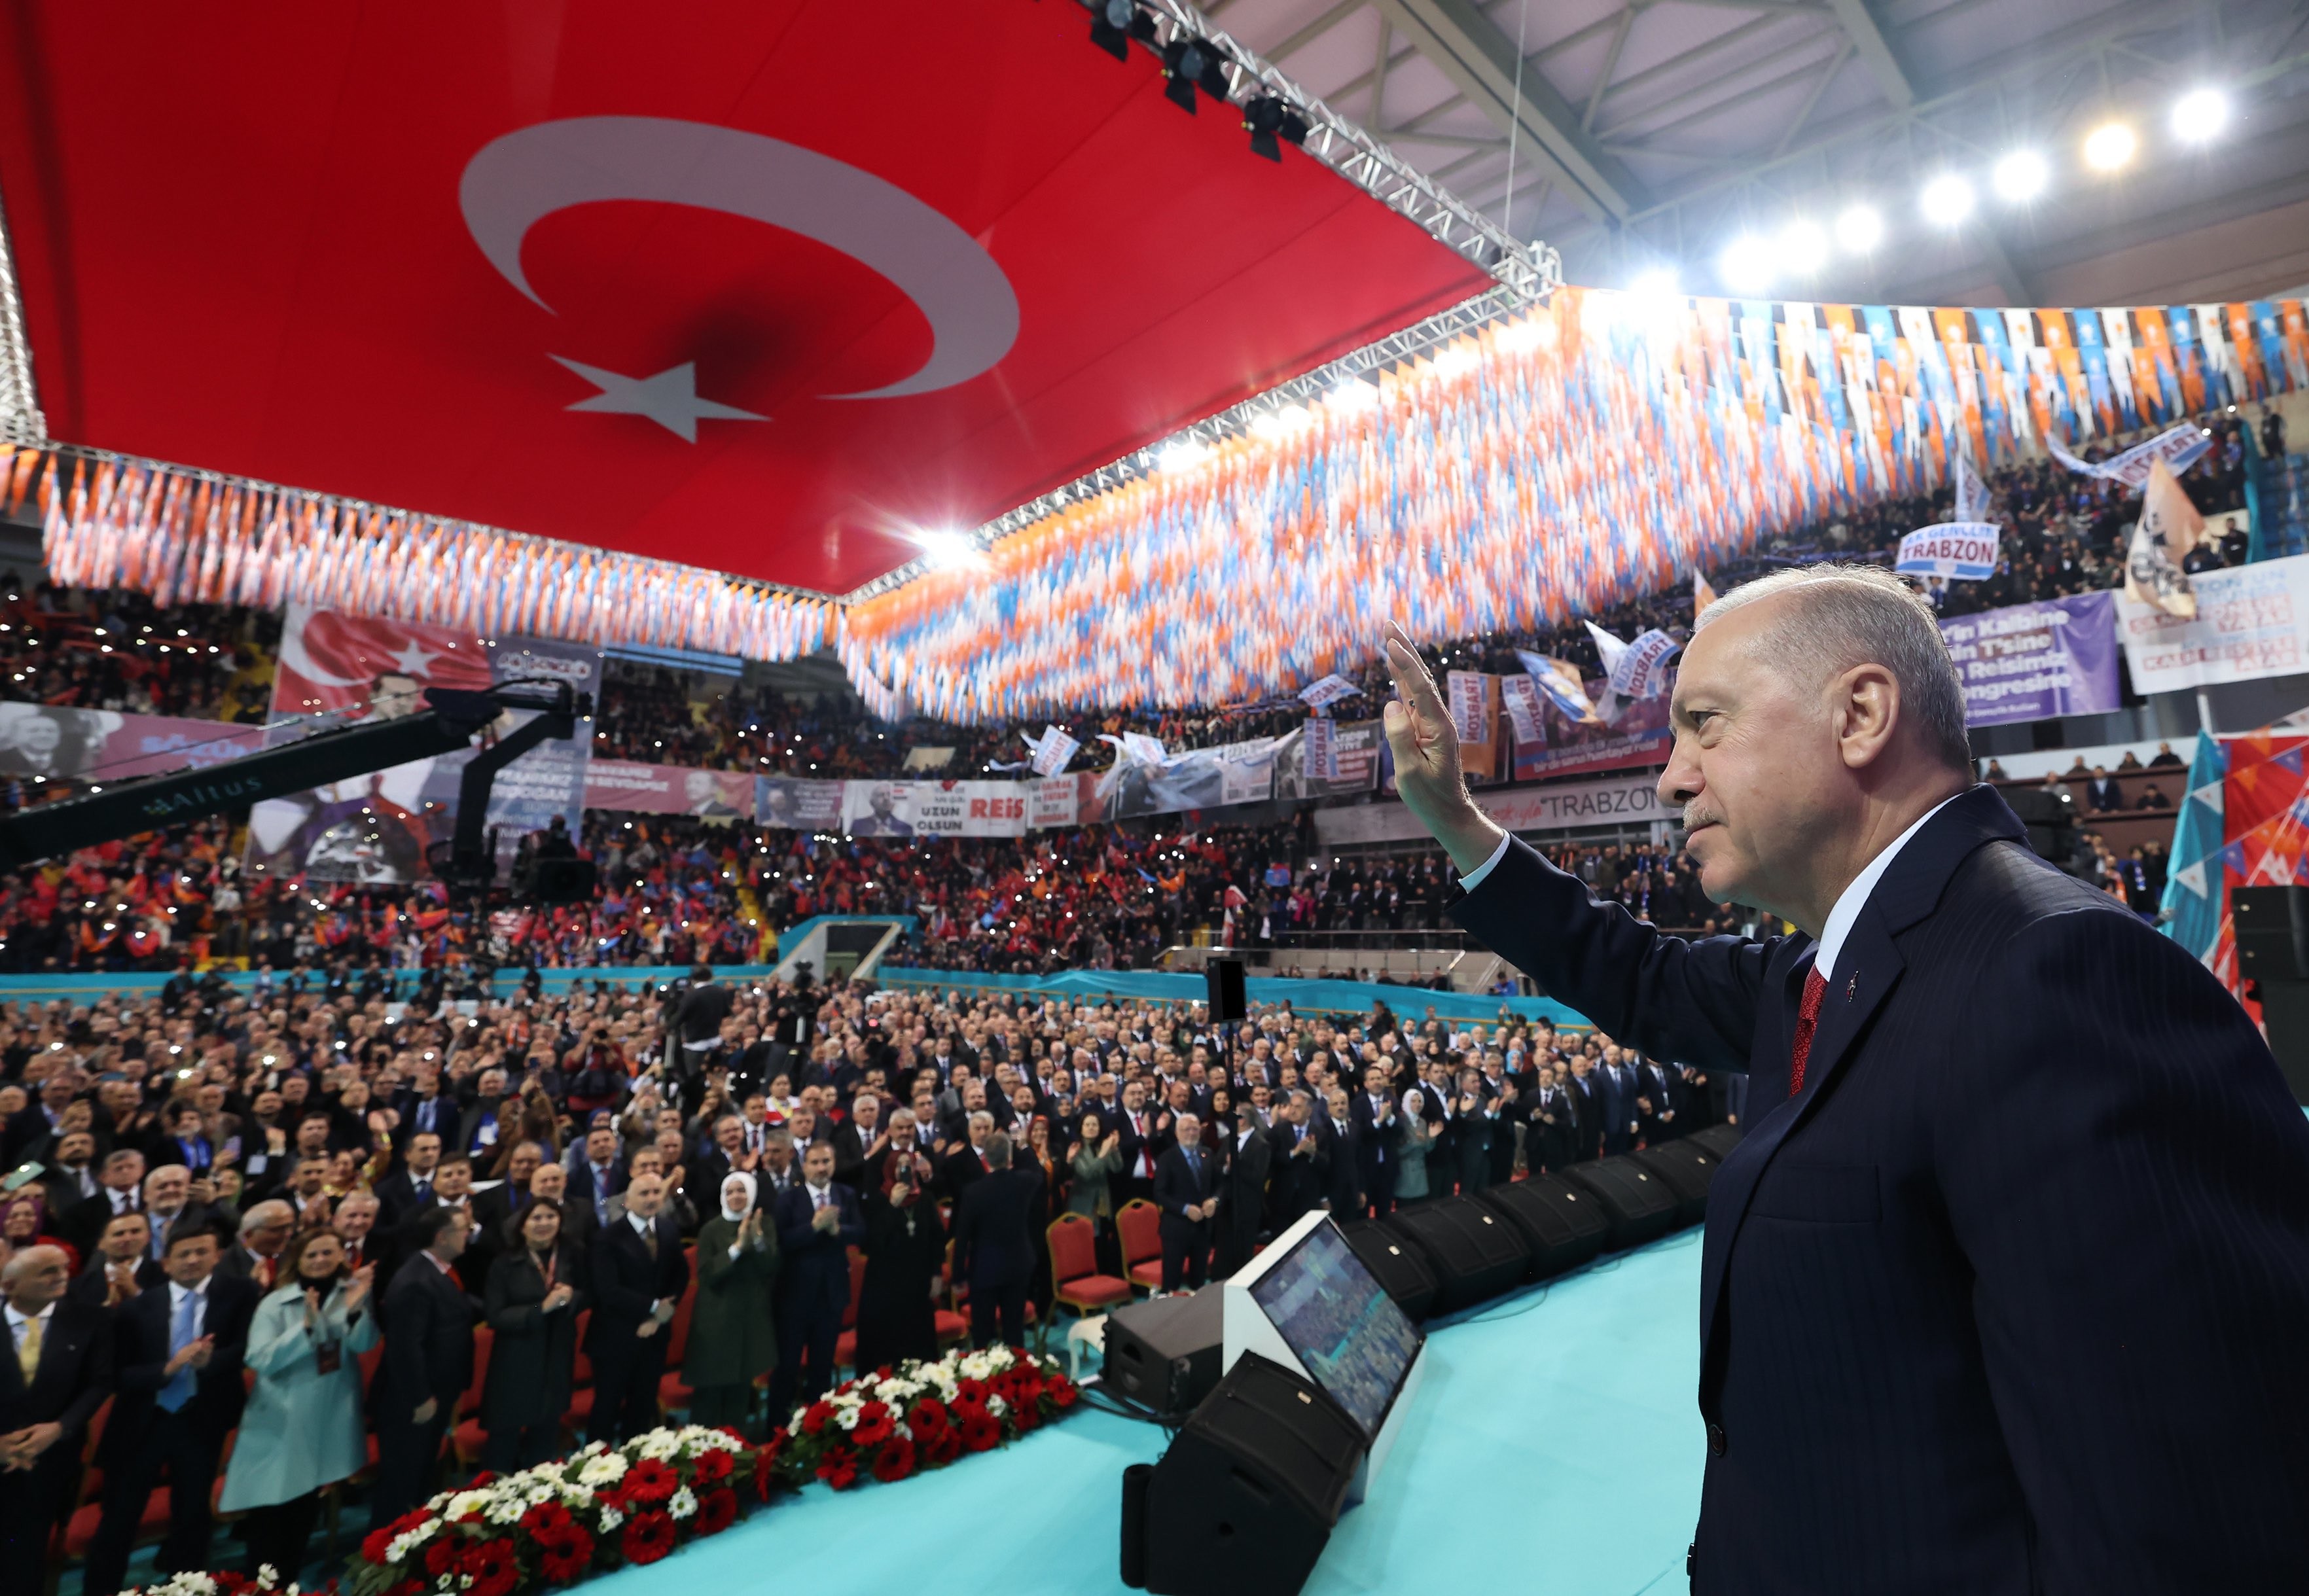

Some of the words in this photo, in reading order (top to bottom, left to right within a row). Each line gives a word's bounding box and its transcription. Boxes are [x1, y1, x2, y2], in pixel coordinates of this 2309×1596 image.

[1904, 539, 1995, 563] TRABZON
[1977, 609, 2070, 639] Kalbine
[1967, 649, 2068, 680] Reisimiz
[921, 807, 960, 817] UZUN
[916, 821, 963, 831] OLSUN
